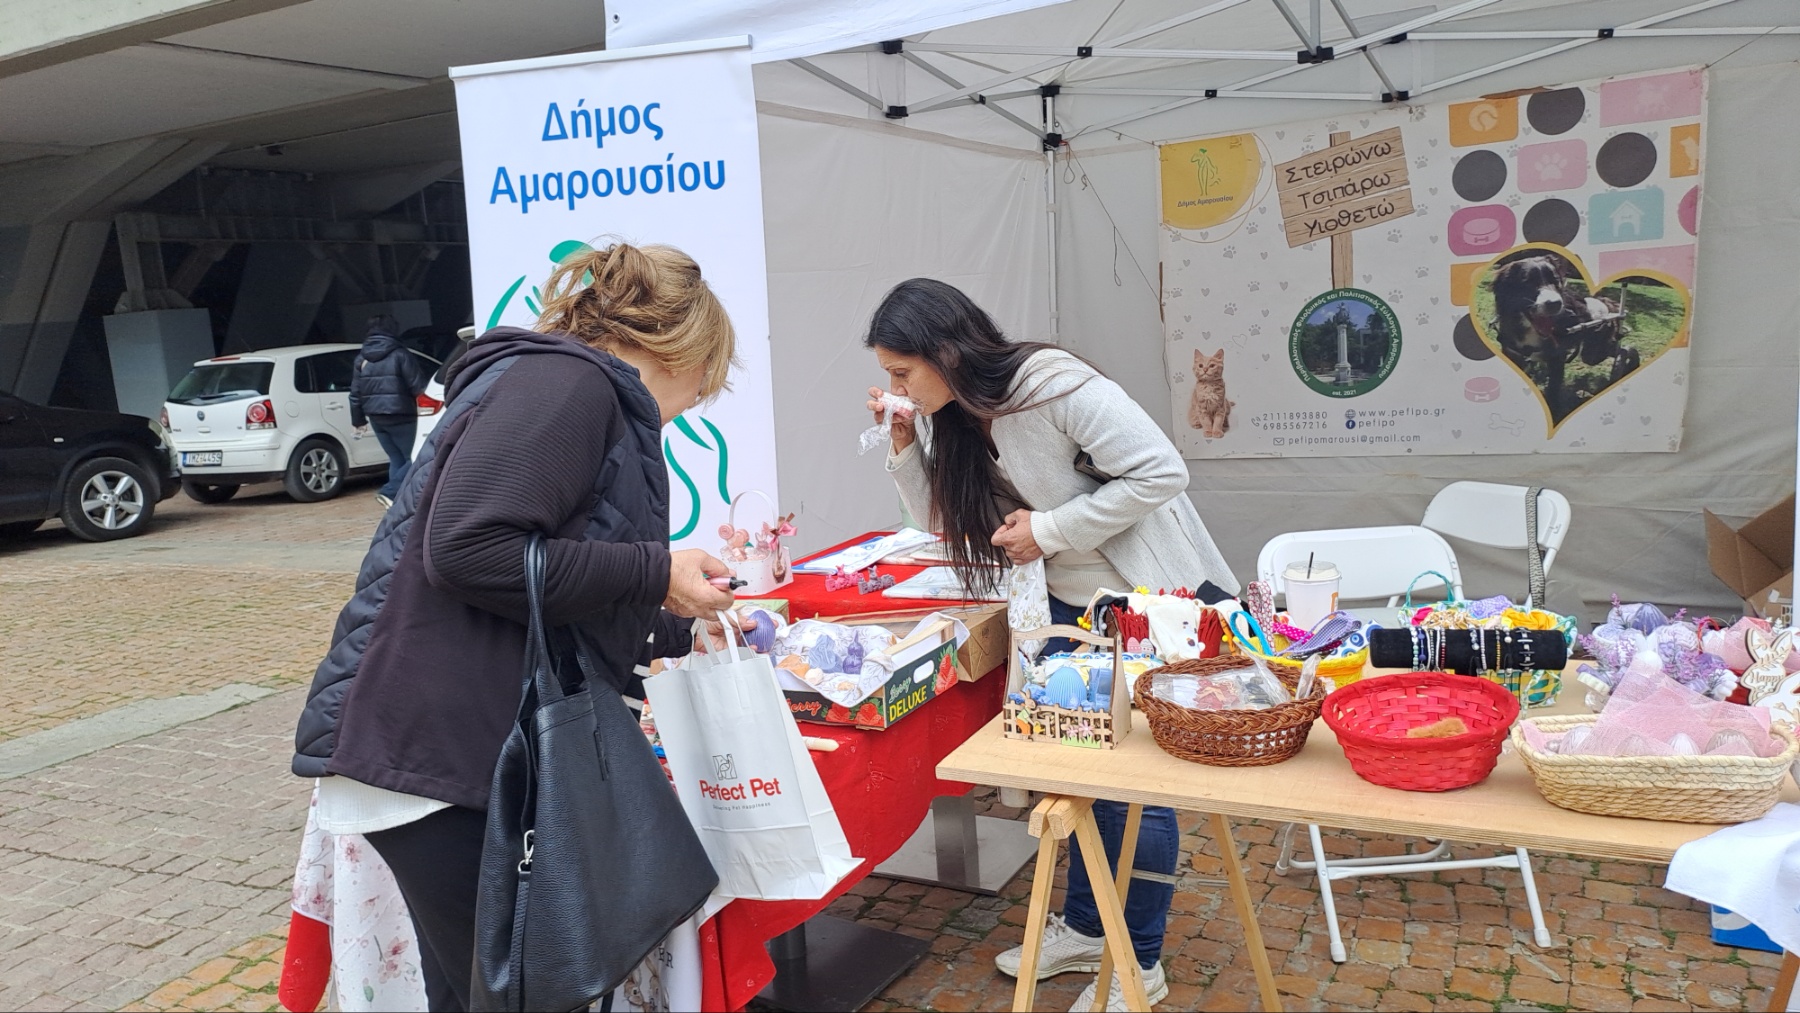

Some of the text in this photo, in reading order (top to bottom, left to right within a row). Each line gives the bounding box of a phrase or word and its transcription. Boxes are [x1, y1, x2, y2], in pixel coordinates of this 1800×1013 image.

[541, 98, 664, 149] Δήμος
[1285, 141, 1392, 184] Στειρώνω
[489, 152, 726, 214] Αμαρουσίου
[1297, 172, 1391, 209] Τσιπάρω
[1303, 198, 1395, 238] Υιοθετώ
[1262, 411, 1328, 421] 2111893880
[1262, 421, 1328, 431] 6985567216
[1358, 407, 1446, 418] www.pefipo.gr
[1358, 419, 1396, 428] pefipo
[1288, 434, 1421, 446] pefipomarousi@gmail.com
[889, 684, 928, 722] DELUXE
[699, 777, 782, 801] Perfect Pet
